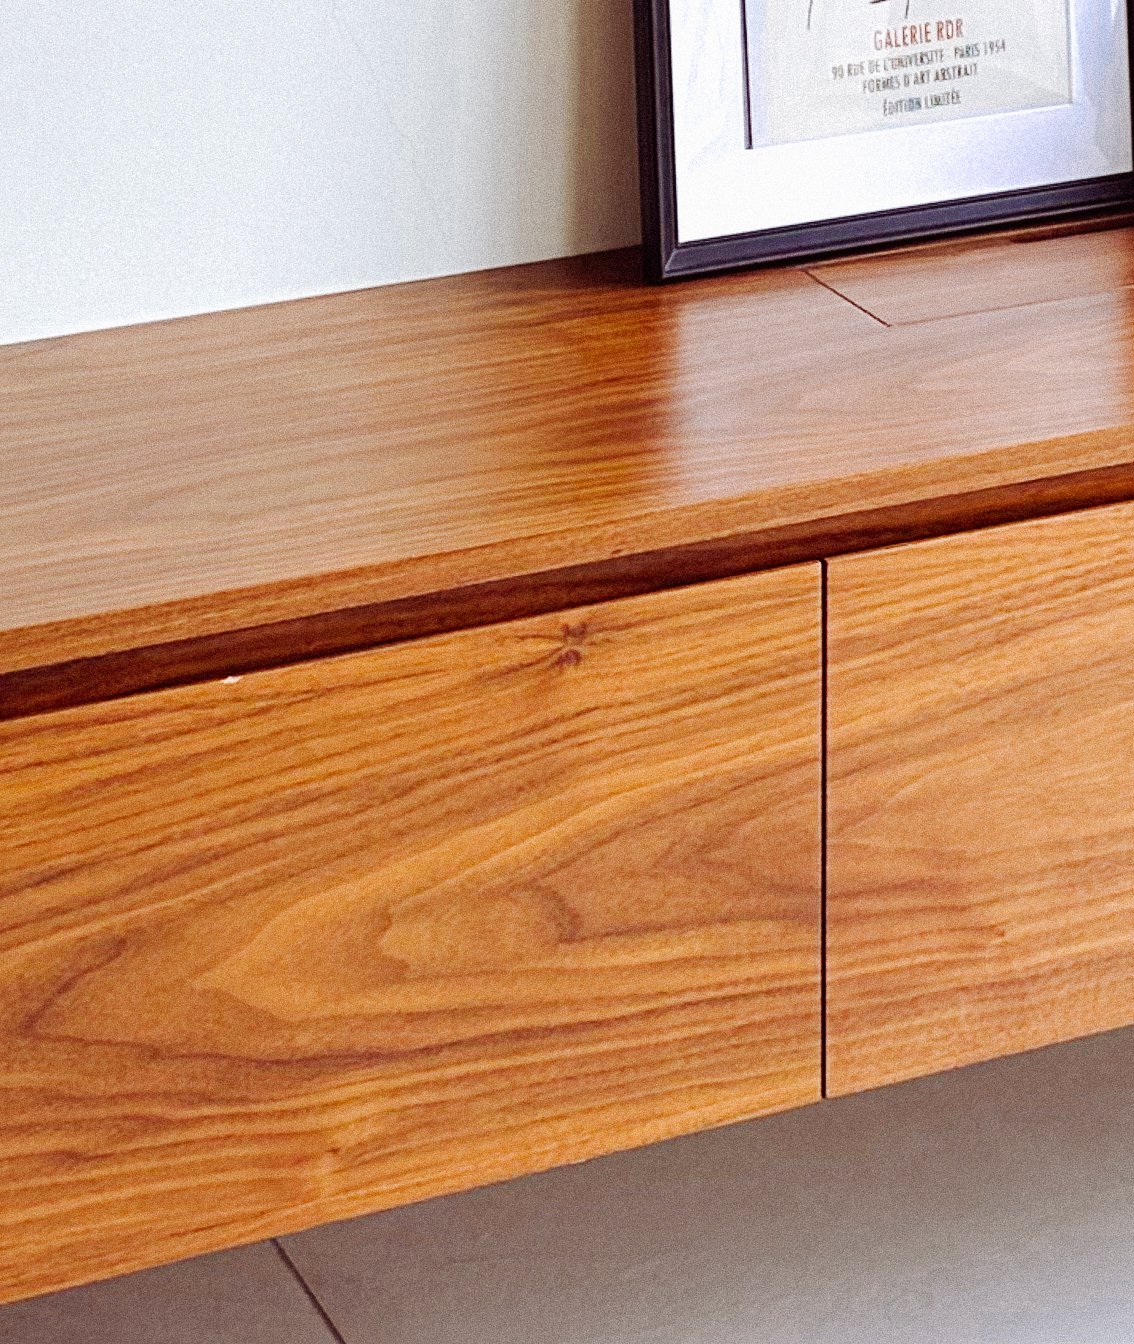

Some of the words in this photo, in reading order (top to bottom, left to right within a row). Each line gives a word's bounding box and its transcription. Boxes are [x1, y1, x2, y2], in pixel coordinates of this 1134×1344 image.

[874, 22, 932, 51] GALERIE
[936, 18, 964, 41] RDR
[847, 61, 865, 77] RUE
[868, 59, 880, 74] DE
[954, 43, 981, 59] PARIS
[862, 75, 900, 94] FORMES
[934, 62, 978, 82] ABSTRAIT
